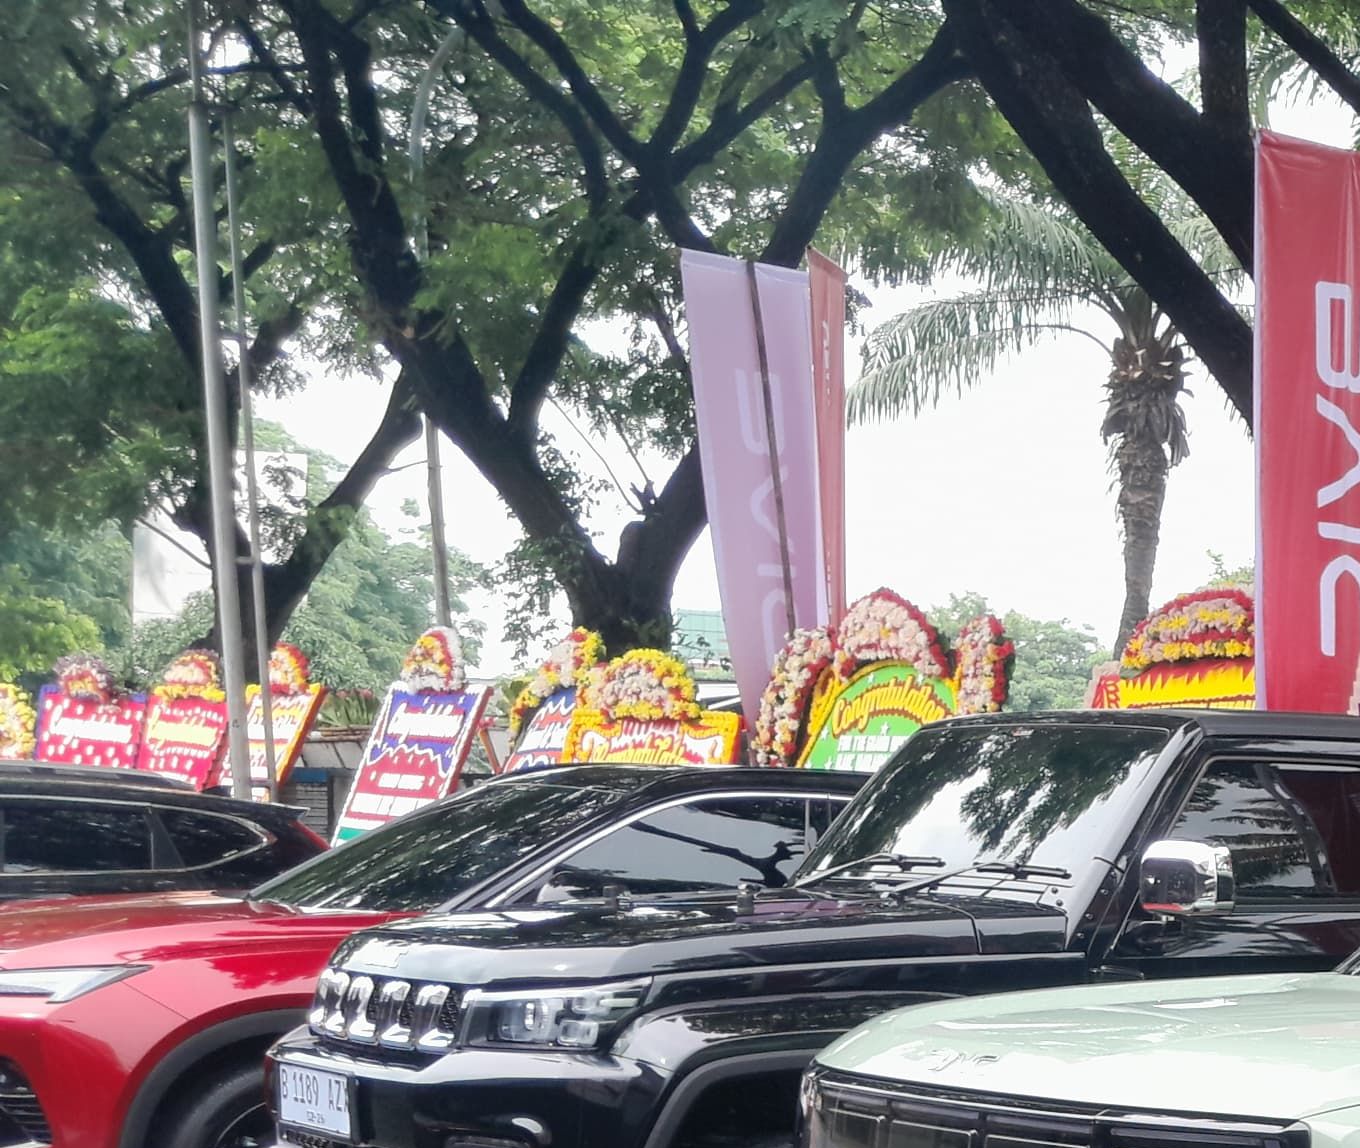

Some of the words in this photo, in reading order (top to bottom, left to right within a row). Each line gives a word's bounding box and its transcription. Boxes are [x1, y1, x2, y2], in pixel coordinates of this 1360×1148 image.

[832, 674, 946, 736] Congratulation
[281, 1068, 289, 1099] B
[293, 1072, 319, 1107] 1189
